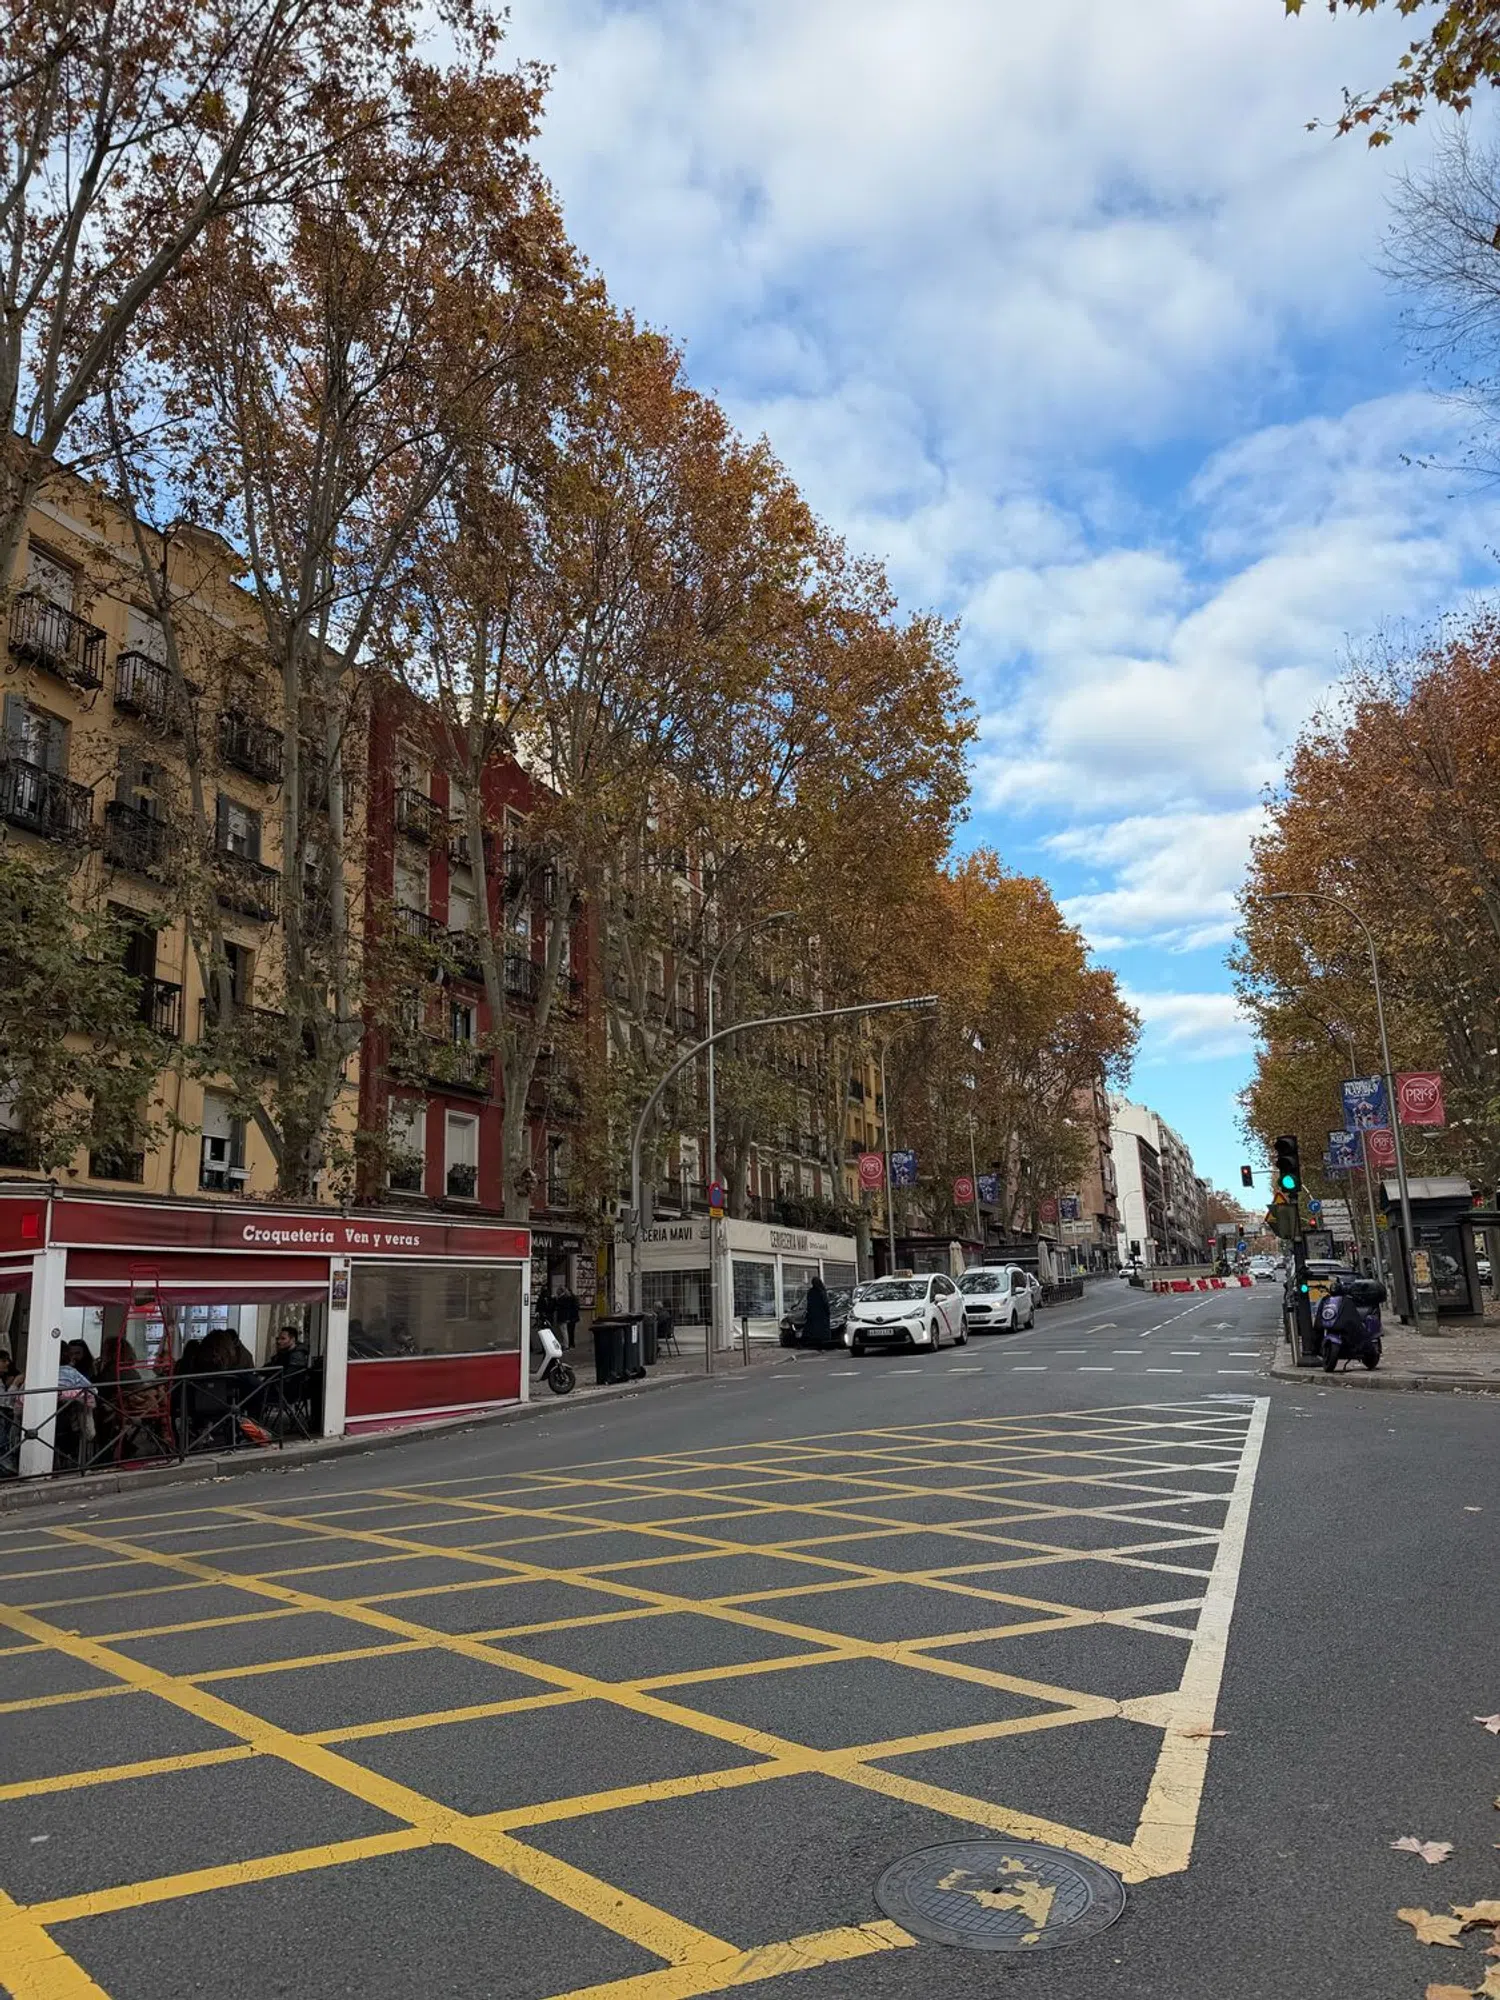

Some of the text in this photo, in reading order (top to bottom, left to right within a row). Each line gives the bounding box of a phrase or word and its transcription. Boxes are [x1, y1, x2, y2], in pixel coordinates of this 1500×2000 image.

[242, 1225, 421, 1247] Croquetería Ven y veras
[670, 1226, 693, 1241] MAVI
